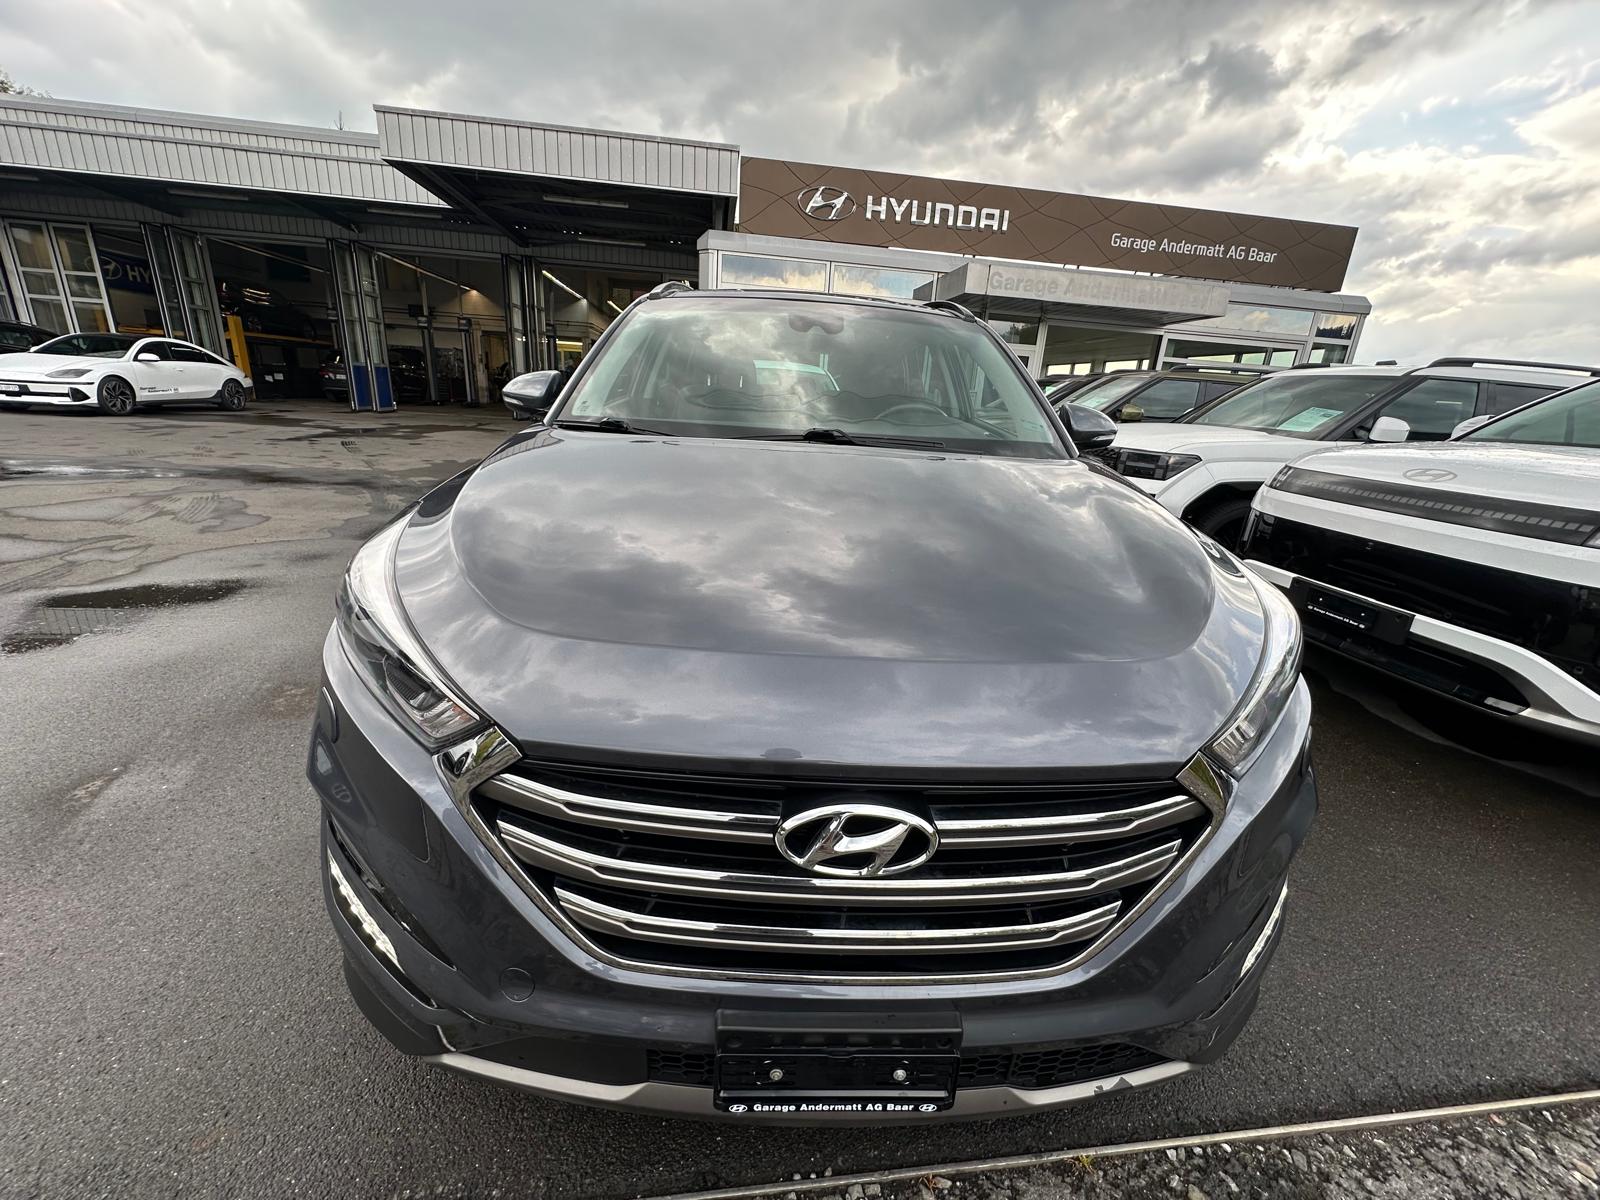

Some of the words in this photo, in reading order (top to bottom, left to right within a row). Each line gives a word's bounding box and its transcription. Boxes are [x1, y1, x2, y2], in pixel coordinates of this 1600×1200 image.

[865, 195, 1010, 232] HYUNDAI
[1111, 233, 1157, 253] Garage
[1159, 238, 1225, 258] Andermatt
[1226, 245, 1246, 260] AG
[1248, 247, 1278, 263] Baar
[989, 271, 1059, 298] Garage
[753, 1103, 796, 1112] Garage
[800, 1103, 862, 1111] Andermatt
[866, 1103, 883, 1111] AG
[886, 1103, 914, 1111] Baar
